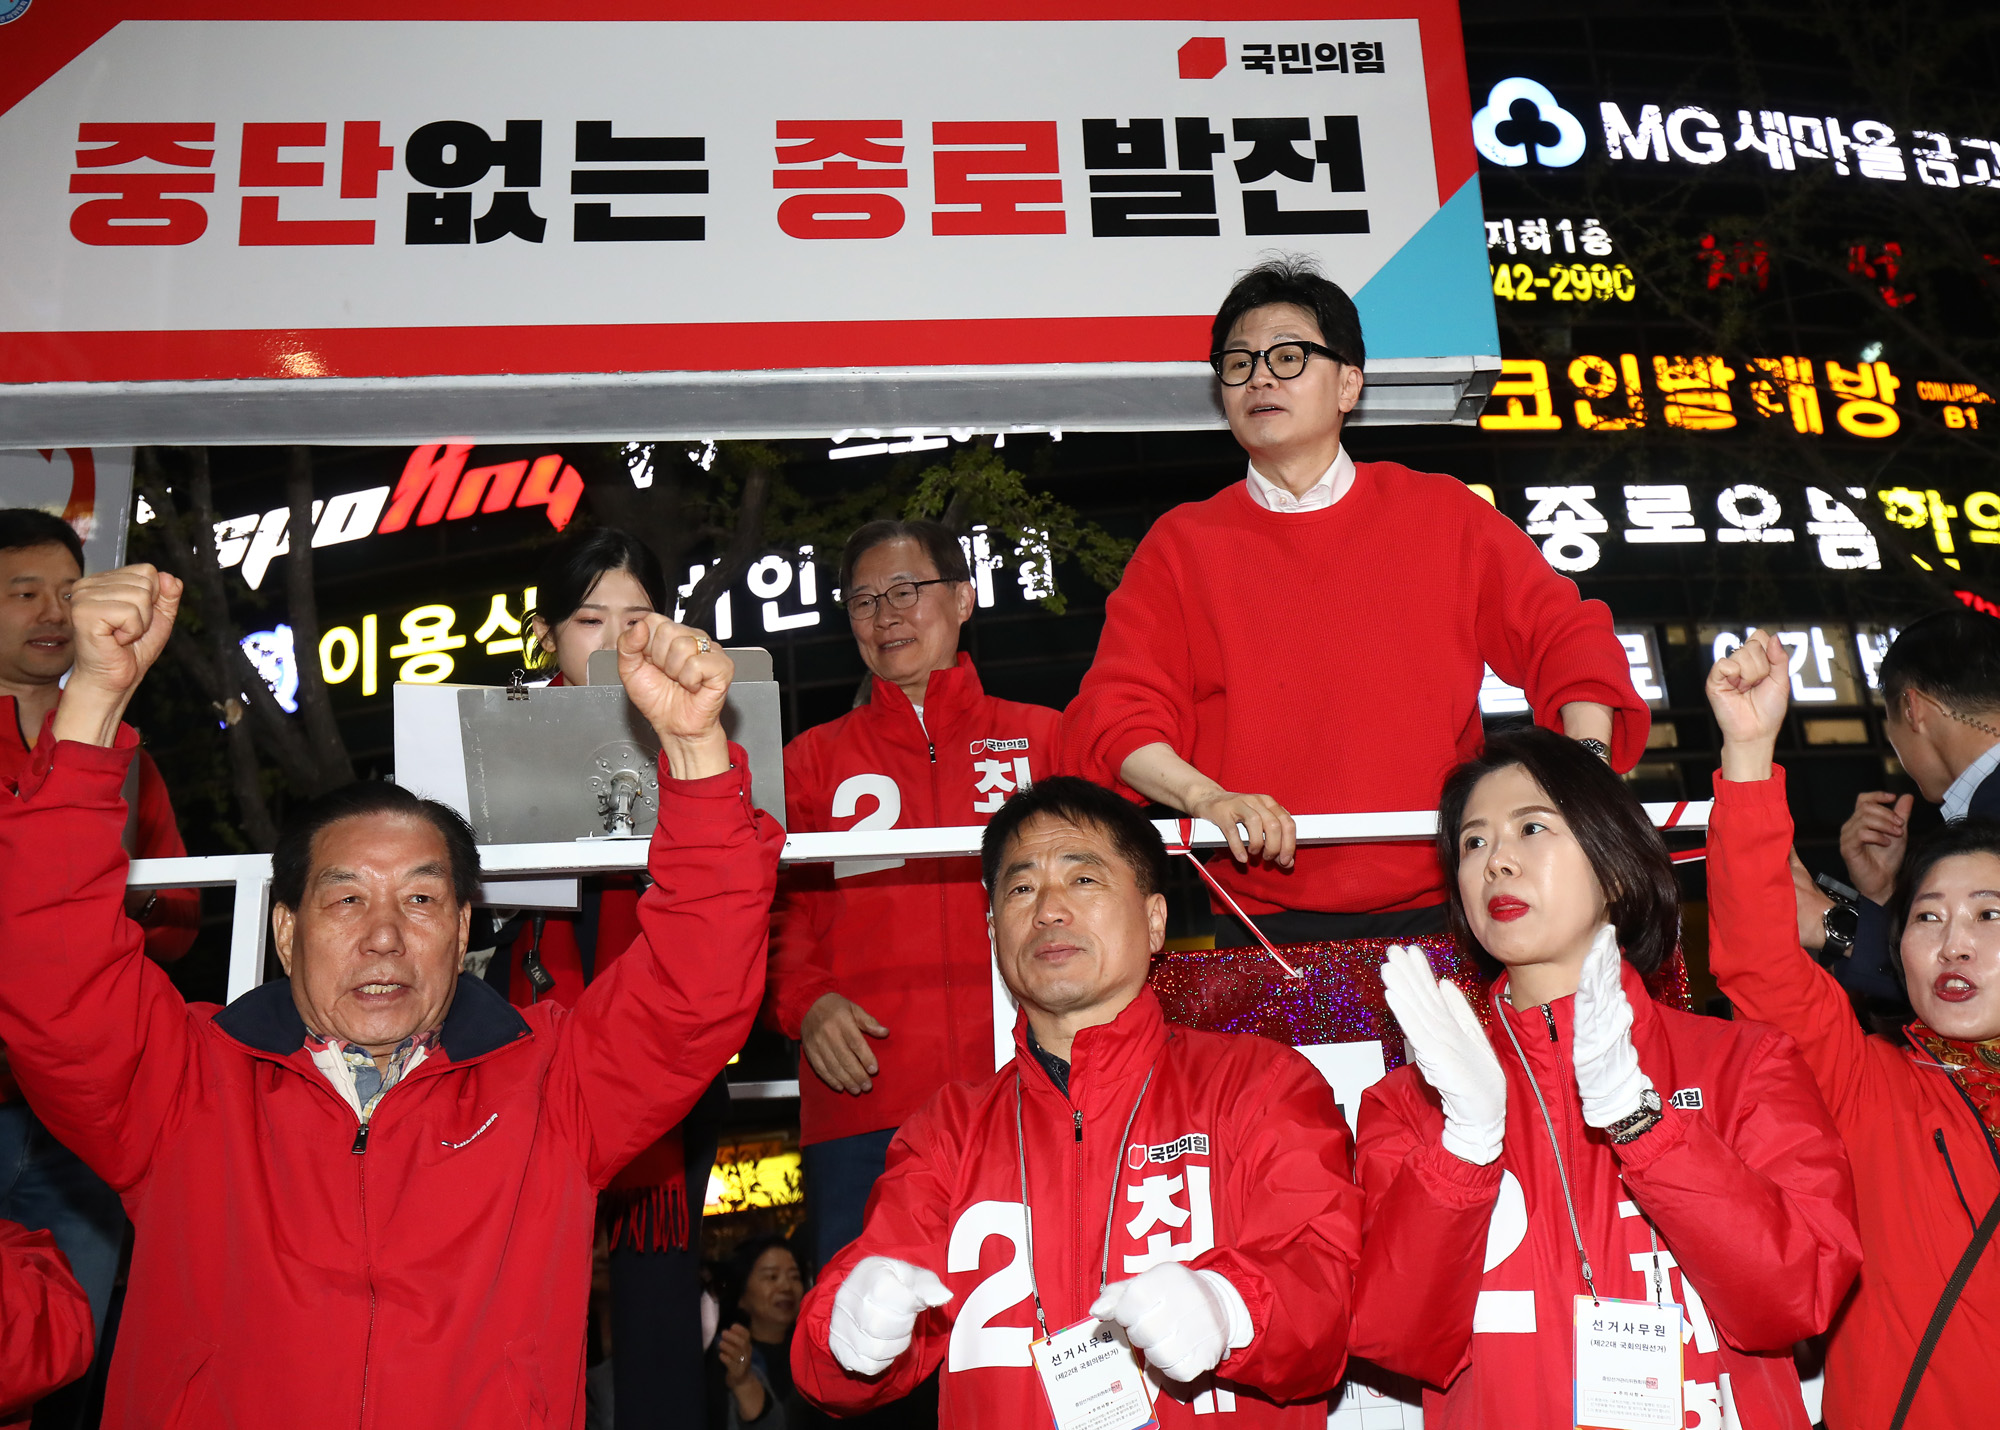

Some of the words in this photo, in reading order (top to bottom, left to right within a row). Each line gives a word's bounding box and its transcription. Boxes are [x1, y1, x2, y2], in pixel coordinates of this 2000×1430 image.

[1241, 42, 1385, 75] 국민의힘
[69, 119, 706, 246] 중단없는
[1490, 263, 1636, 302] 42-2990
[986, 739, 1029, 750] 국민의힘
[1150, 1135, 1208, 1162] 국민의힘
[947, 1200, 1034, 1373] 2
